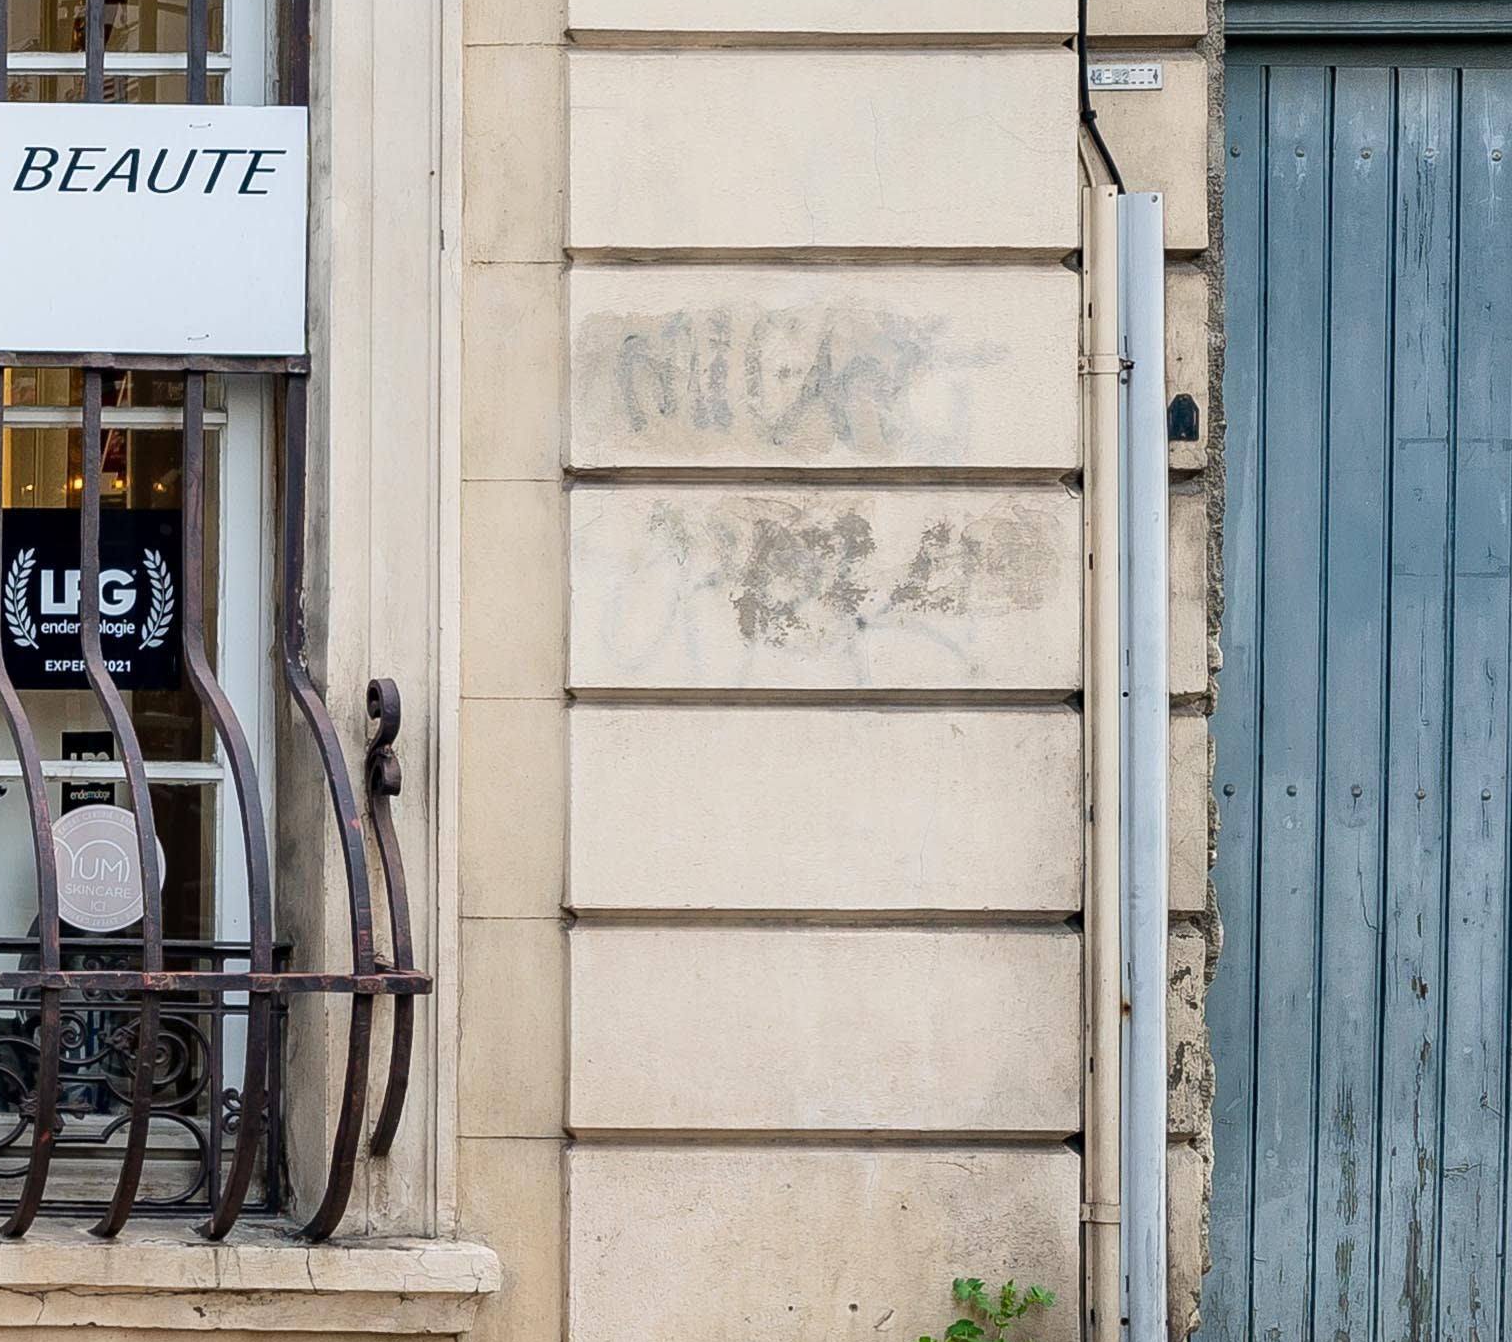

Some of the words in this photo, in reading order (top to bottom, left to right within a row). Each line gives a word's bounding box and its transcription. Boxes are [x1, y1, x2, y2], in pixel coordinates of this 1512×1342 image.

[12, 146, 287, 196] BEAUTE
[41, 619, 136, 638] enderlogie
[45, 660, 86, 672] EXPER
[65, 882, 132, 898] SKINCARE
